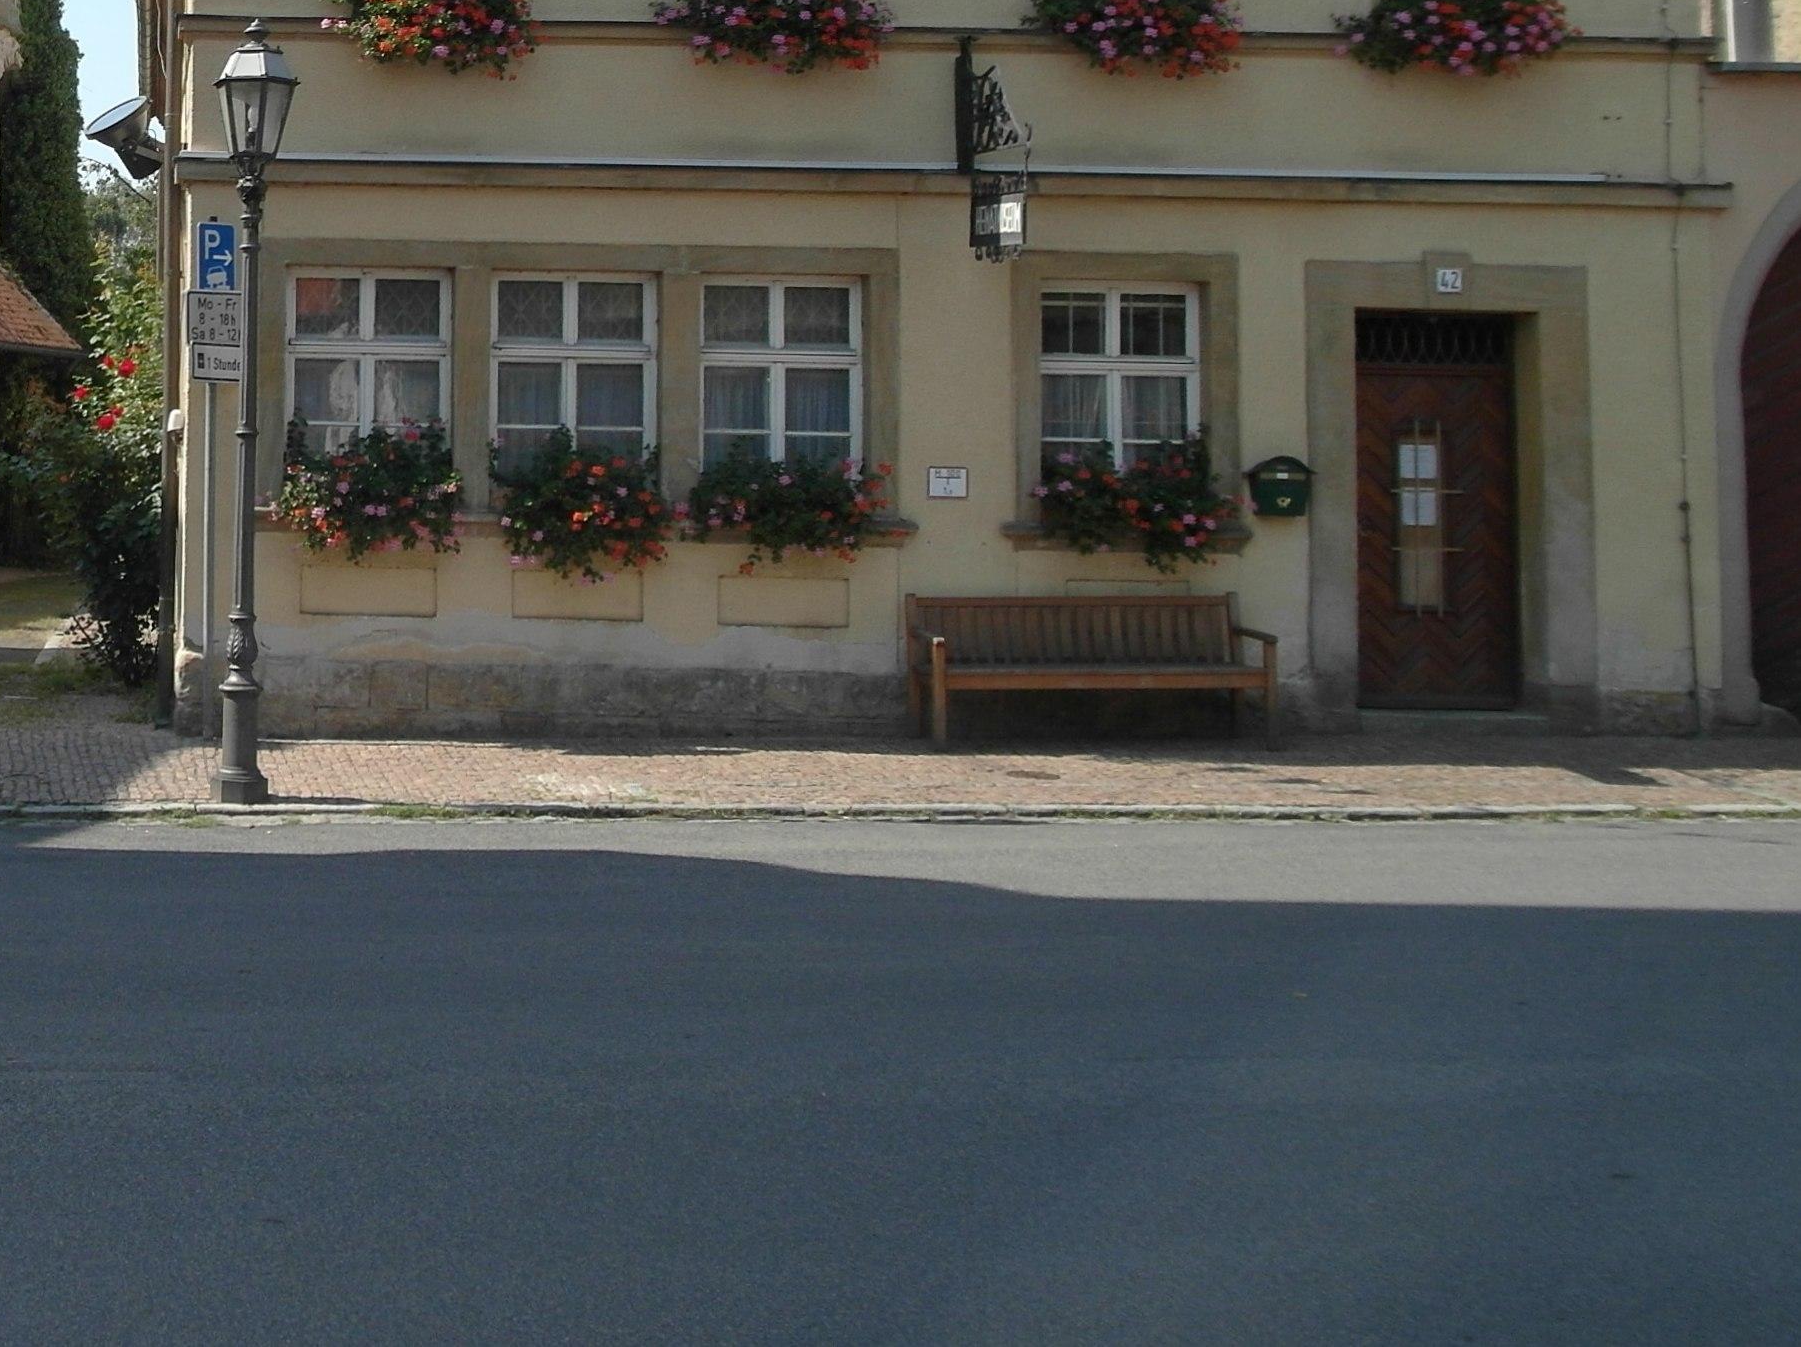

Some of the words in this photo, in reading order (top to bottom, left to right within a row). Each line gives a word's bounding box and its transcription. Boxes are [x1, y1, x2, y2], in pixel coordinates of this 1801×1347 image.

[204, 229, 221, 260] P
[1440, 271, 1460, 290] 42
[198, 297, 214, 310] Mo
[225, 298, 237, 311] Fr
[198, 312, 206, 325] 8
[191, 327, 206, 340] Sa
[209, 328, 216, 341] 8
